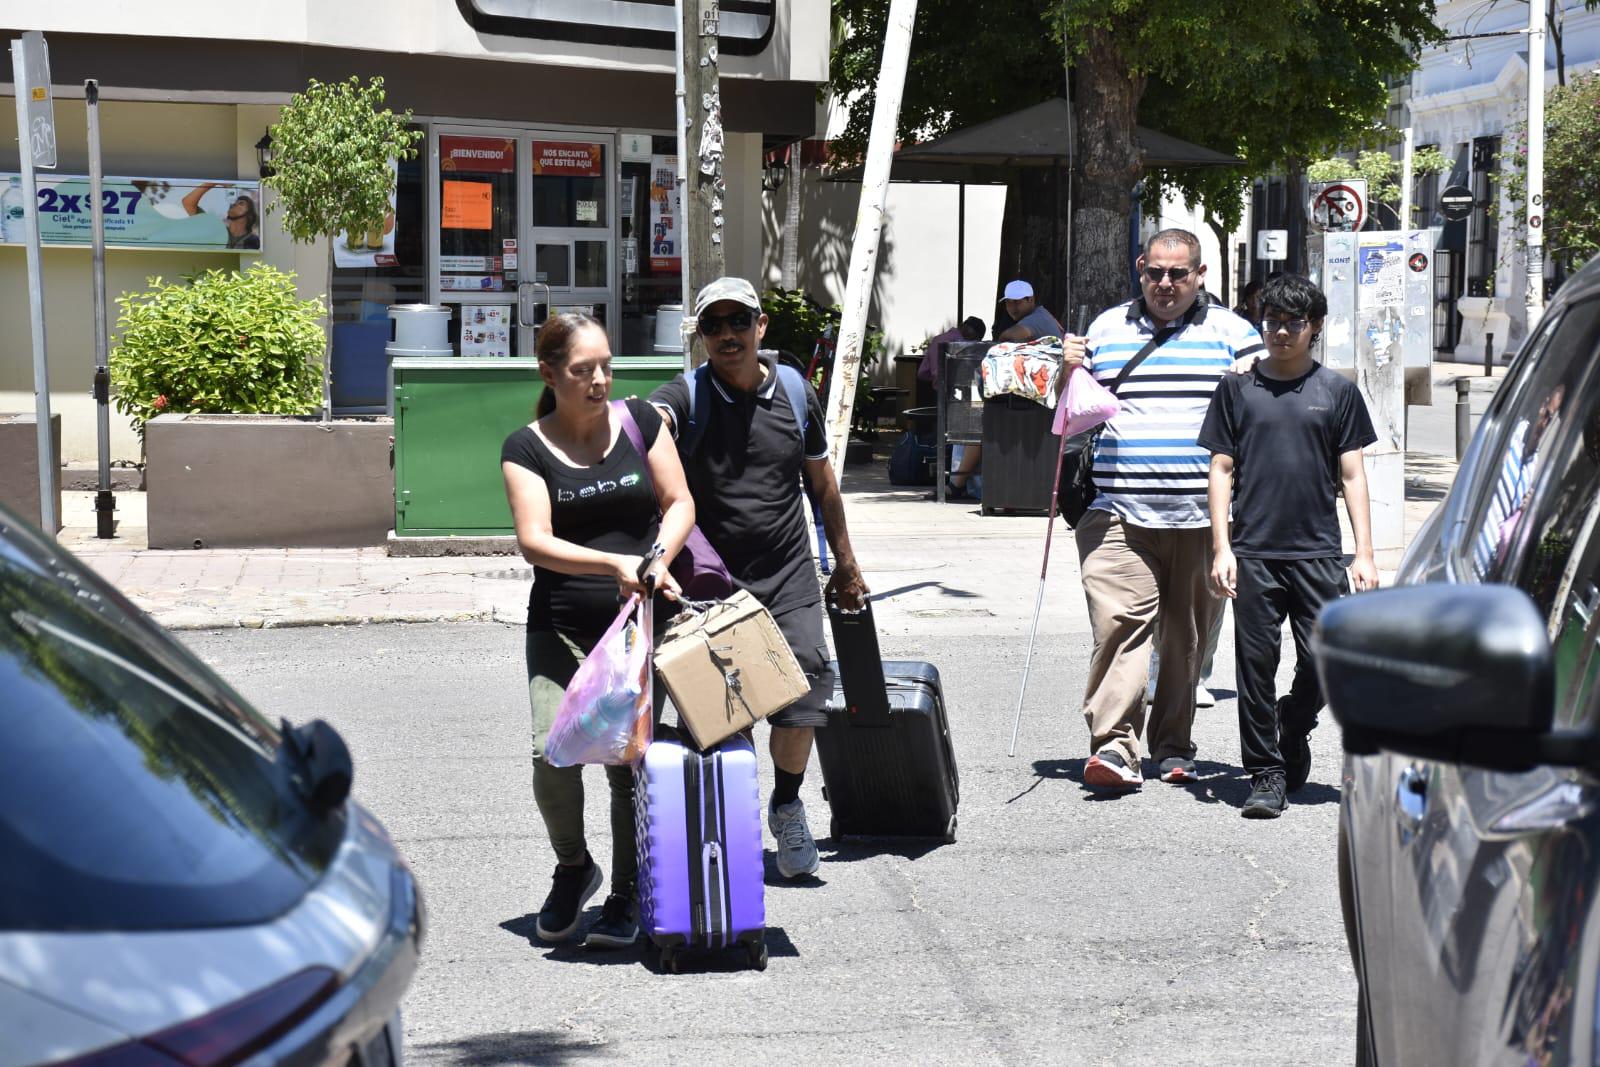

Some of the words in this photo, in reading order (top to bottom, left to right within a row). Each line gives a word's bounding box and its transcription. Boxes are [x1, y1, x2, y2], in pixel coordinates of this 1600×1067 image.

[450, 149, 504, 160] ¡BIENVENIDO!
[543, 149, 557, 157] NOS
[558, 149, 589, 158] ENCANTA
[540, 158, 553, 167] QUE
[576, 158, 592, 168] AQUÍ
[557, 474, 639, 502] bebe
